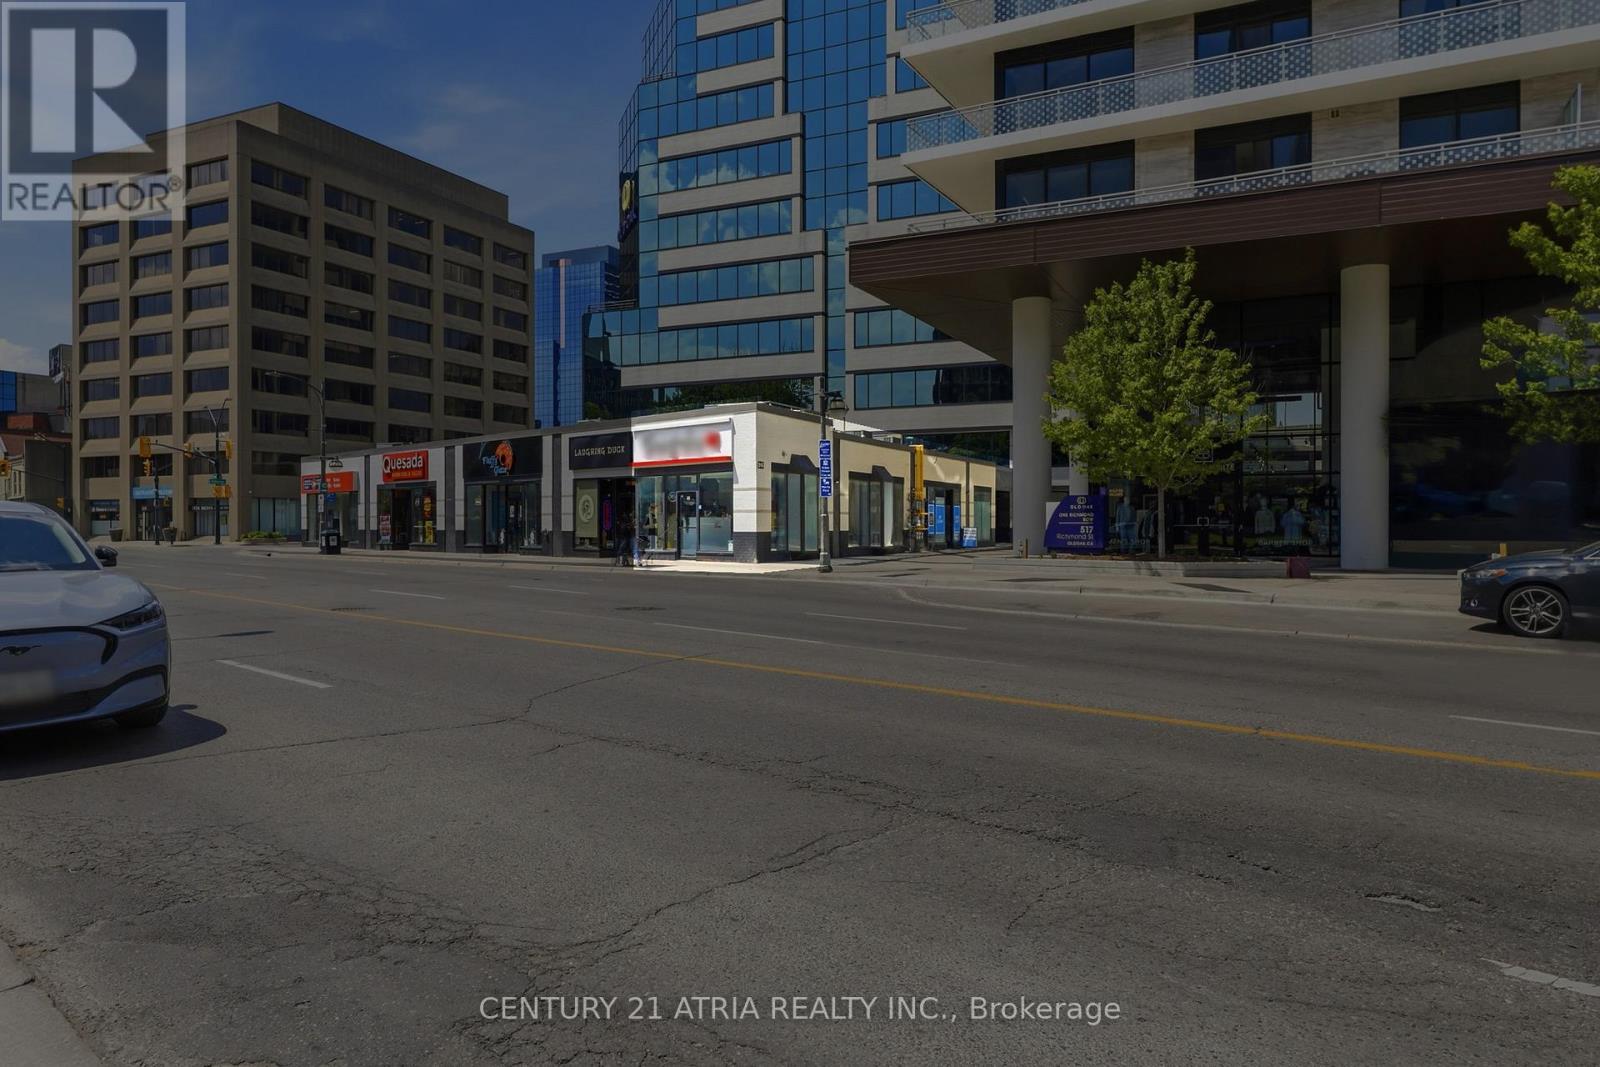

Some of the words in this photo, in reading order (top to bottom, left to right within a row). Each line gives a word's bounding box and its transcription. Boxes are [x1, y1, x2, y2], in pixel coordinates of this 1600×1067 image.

[574, 447, 605, 457] LAUGHING
[607, 445, 625, 455] DUCK
[383, 454, 423, 473] Quesada
[1080, 525, 1094, 533] 517
